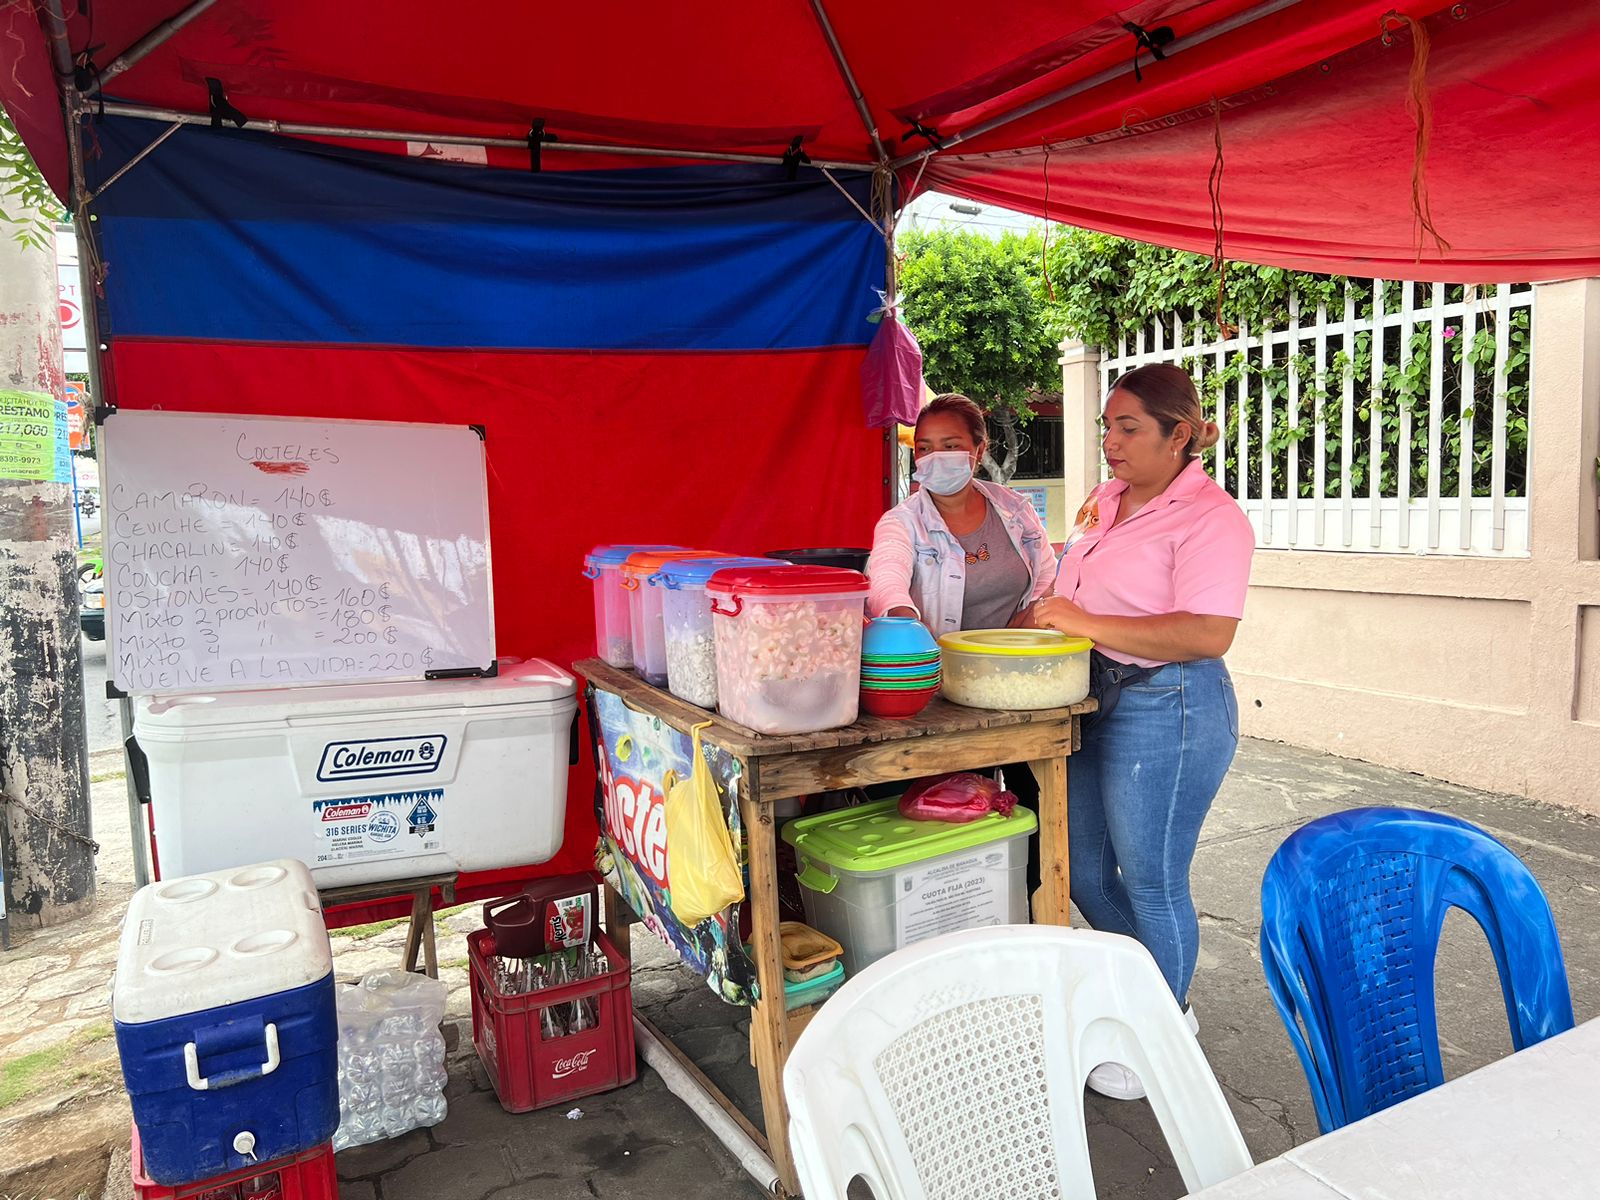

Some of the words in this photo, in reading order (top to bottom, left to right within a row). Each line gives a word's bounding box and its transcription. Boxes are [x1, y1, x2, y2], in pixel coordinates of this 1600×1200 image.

[195, 609, 212, 625] 2
[200, 629, 219, 644] 3
[208, 644, 219, 660] 4
[230, 658, 246, 679] A
[333, 746, 415, 768] Coleman
[325, 806, 361, 819] Coleman
[598, 744, 671, 882] Cocte
[326, 826, 339, 837] 316
[341, 825, 367, 835] SERIES
[368, 823, 397, 835] WICHITA
[921, 888, 946, 900] CUOTA
[947, 882, 963, 893] FIJA
[964, 877, 986, 889] (2023)
